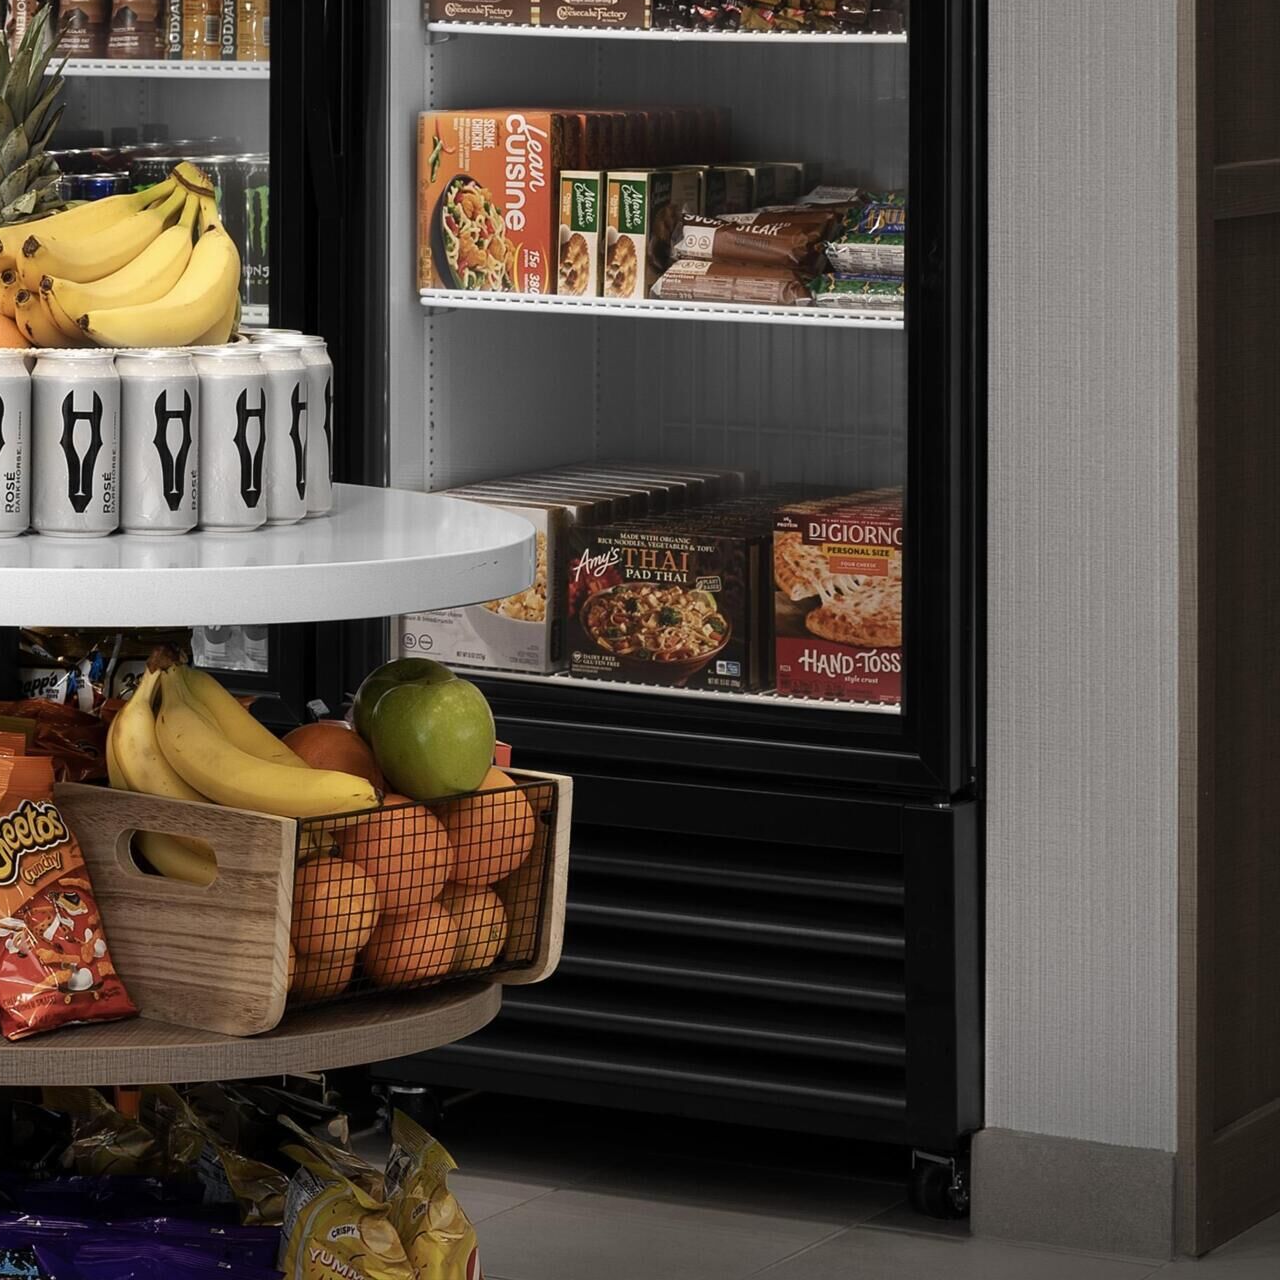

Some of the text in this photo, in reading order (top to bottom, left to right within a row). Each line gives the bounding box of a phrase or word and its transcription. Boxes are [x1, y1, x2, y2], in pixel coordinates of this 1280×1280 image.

[472, 119, 482, 151] CHICKEN
[483, 119, 494, 149] SESAME
[524, 115, 548, 191] Lean
[574, 547, 620, 581] Amy's
[623, 548, 690, 573] THAI
[827, 546, 890, 557] PERSONAL SIZE
[626, 570, 688, 583] PAD THAI
